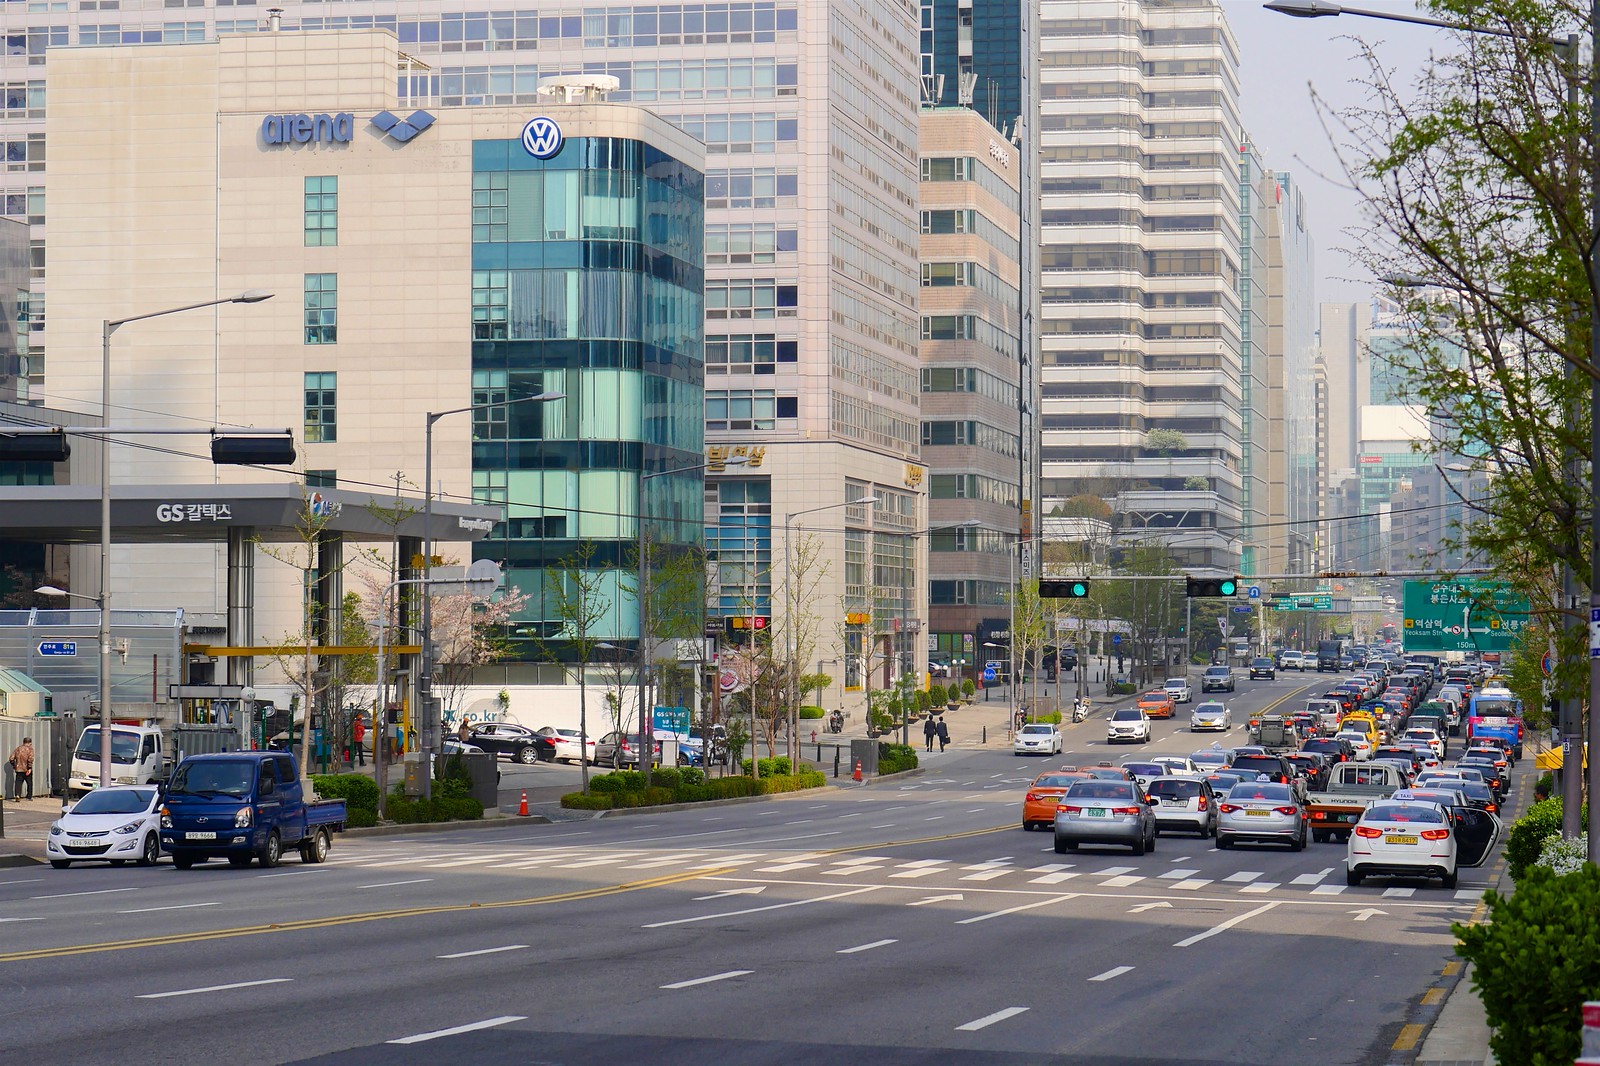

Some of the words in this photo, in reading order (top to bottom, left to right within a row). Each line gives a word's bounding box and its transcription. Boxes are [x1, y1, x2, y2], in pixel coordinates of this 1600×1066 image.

[262, 112, 353, 145] arena
[1415, 619, 1442, 629] 역삼역
[1456, 641, 1476, 649] 150m
